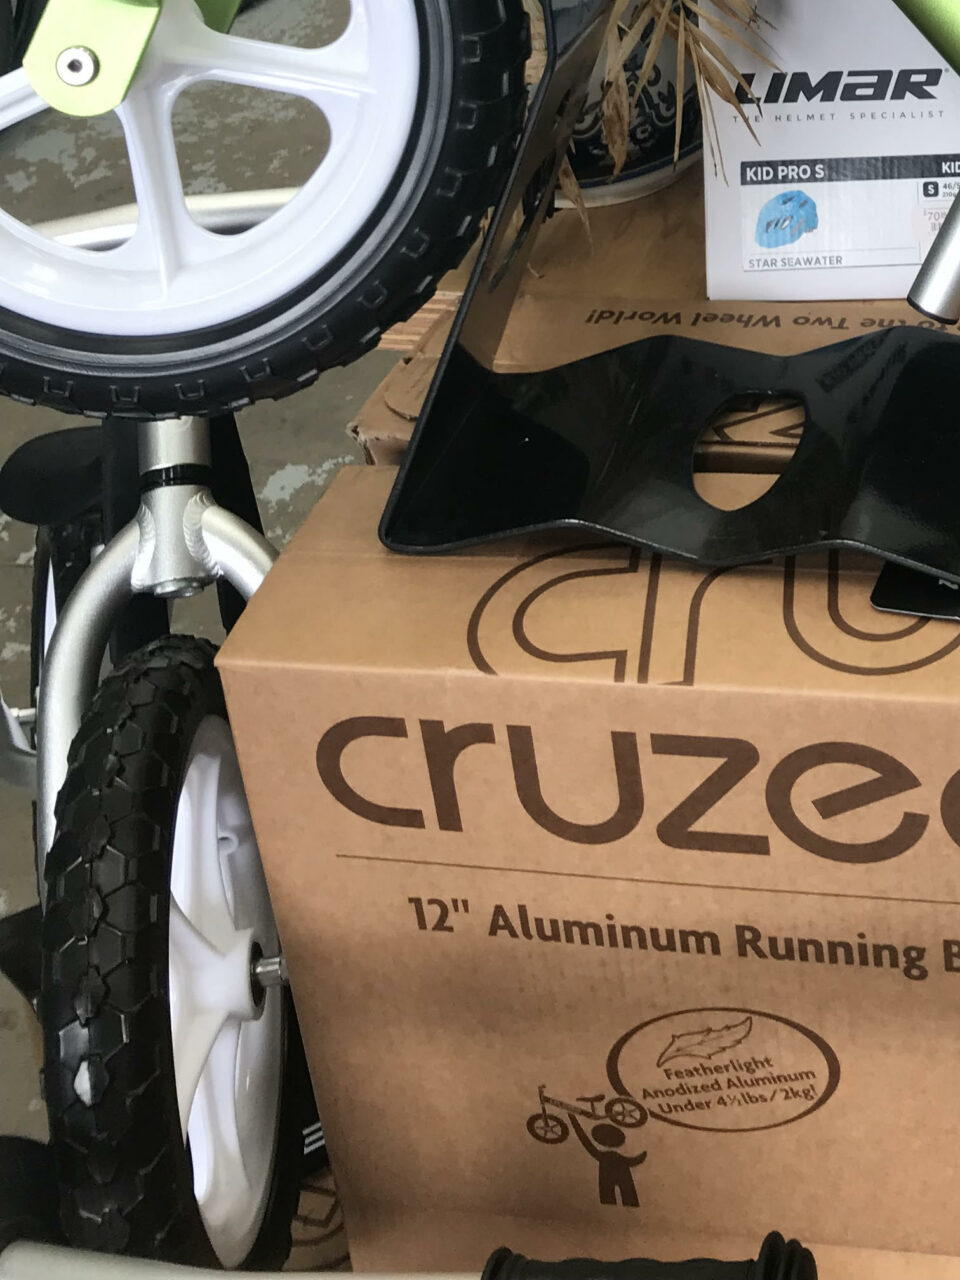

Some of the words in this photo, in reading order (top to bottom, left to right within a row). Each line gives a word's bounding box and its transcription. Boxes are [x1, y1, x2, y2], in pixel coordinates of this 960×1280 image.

[733, 115, 761, 124] TE
[774, 112, 837, 122] HELMET
[849, 110, 945, 120] SPECIALIST
[746, 167, 774, 181] KID
[778, 166, 811, 180] PRO
[815, 165, 825, 178] S
[927, 184, 935, 194] S
[749, 258, 778, 269] STAR
[781, 255, 843, 267] SEAWATER
[585, 308, 682, 325] World!
[690, 312, 782, 328] Wheel
[792, 315, 849, 330] Two
[408, 896, 470, 932] 12"
[488, 903, 721, 956] Aluminum
[737, 924, 927, 980] Running
[664, 1056, 774, 1081] Featherlight
[642, 1079, 722, 1100] Anodized
[727, 1070, 816, 1090] Aluminum
[658, 1099, 712, 1114] Under
